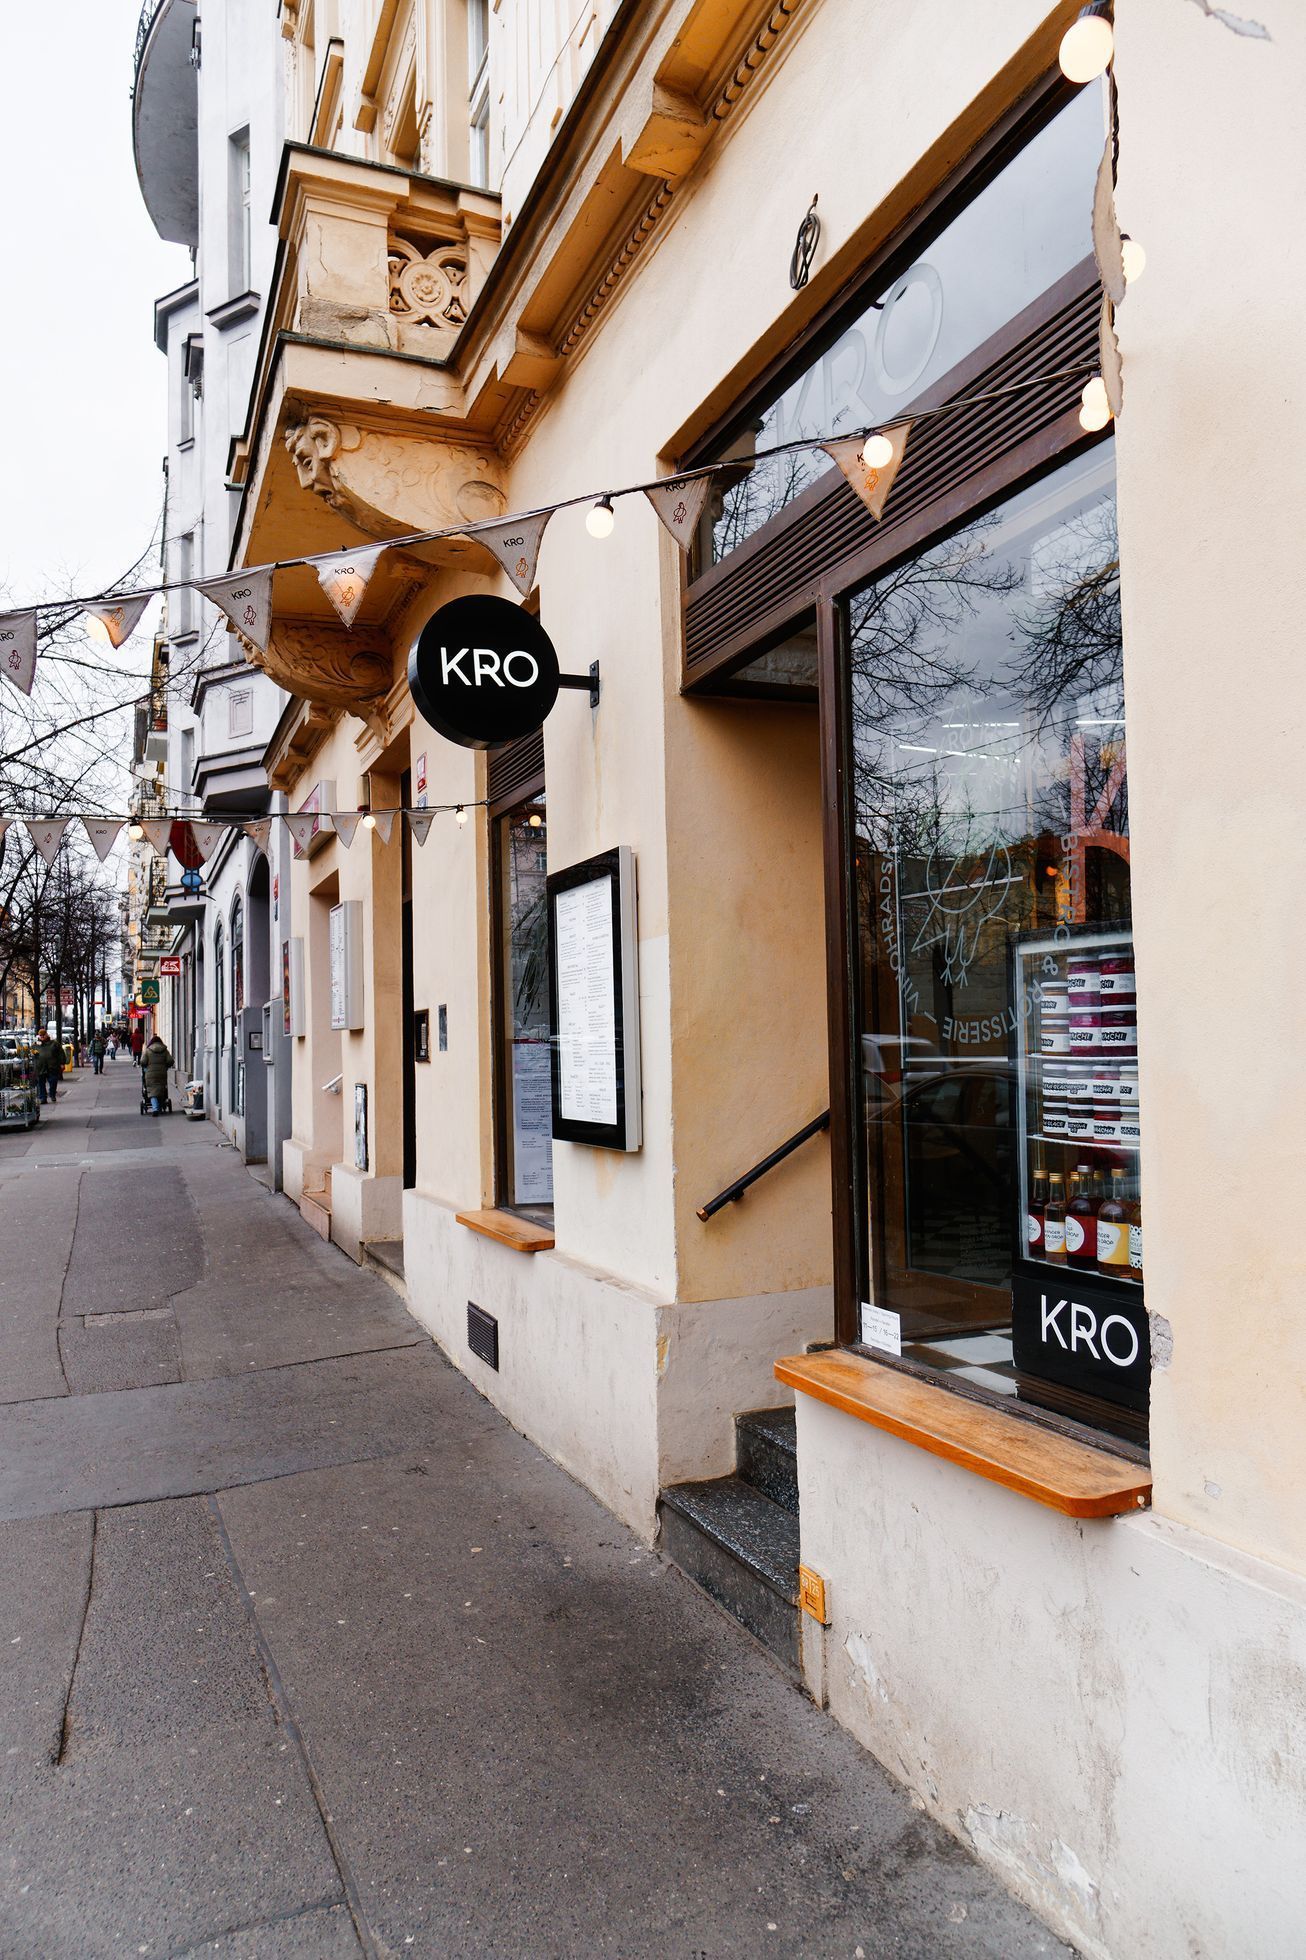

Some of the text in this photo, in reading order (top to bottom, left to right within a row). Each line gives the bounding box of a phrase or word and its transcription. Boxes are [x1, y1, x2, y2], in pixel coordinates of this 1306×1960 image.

[665, 481, 687, 493] KRO
[503, 537, 525, 547] KRO
[334, 567, 355, 576] KRO
[231, 588, 252, 600] KRO
[0, 631, 15, 641] RO
[440, 646, 539, 688] KRO
[1055, 832, 1080, 943] BISTRO
[942, 978, 1045, 1044] ROTISSERIE
[1041, 1293, 1139, 1367] KRO
